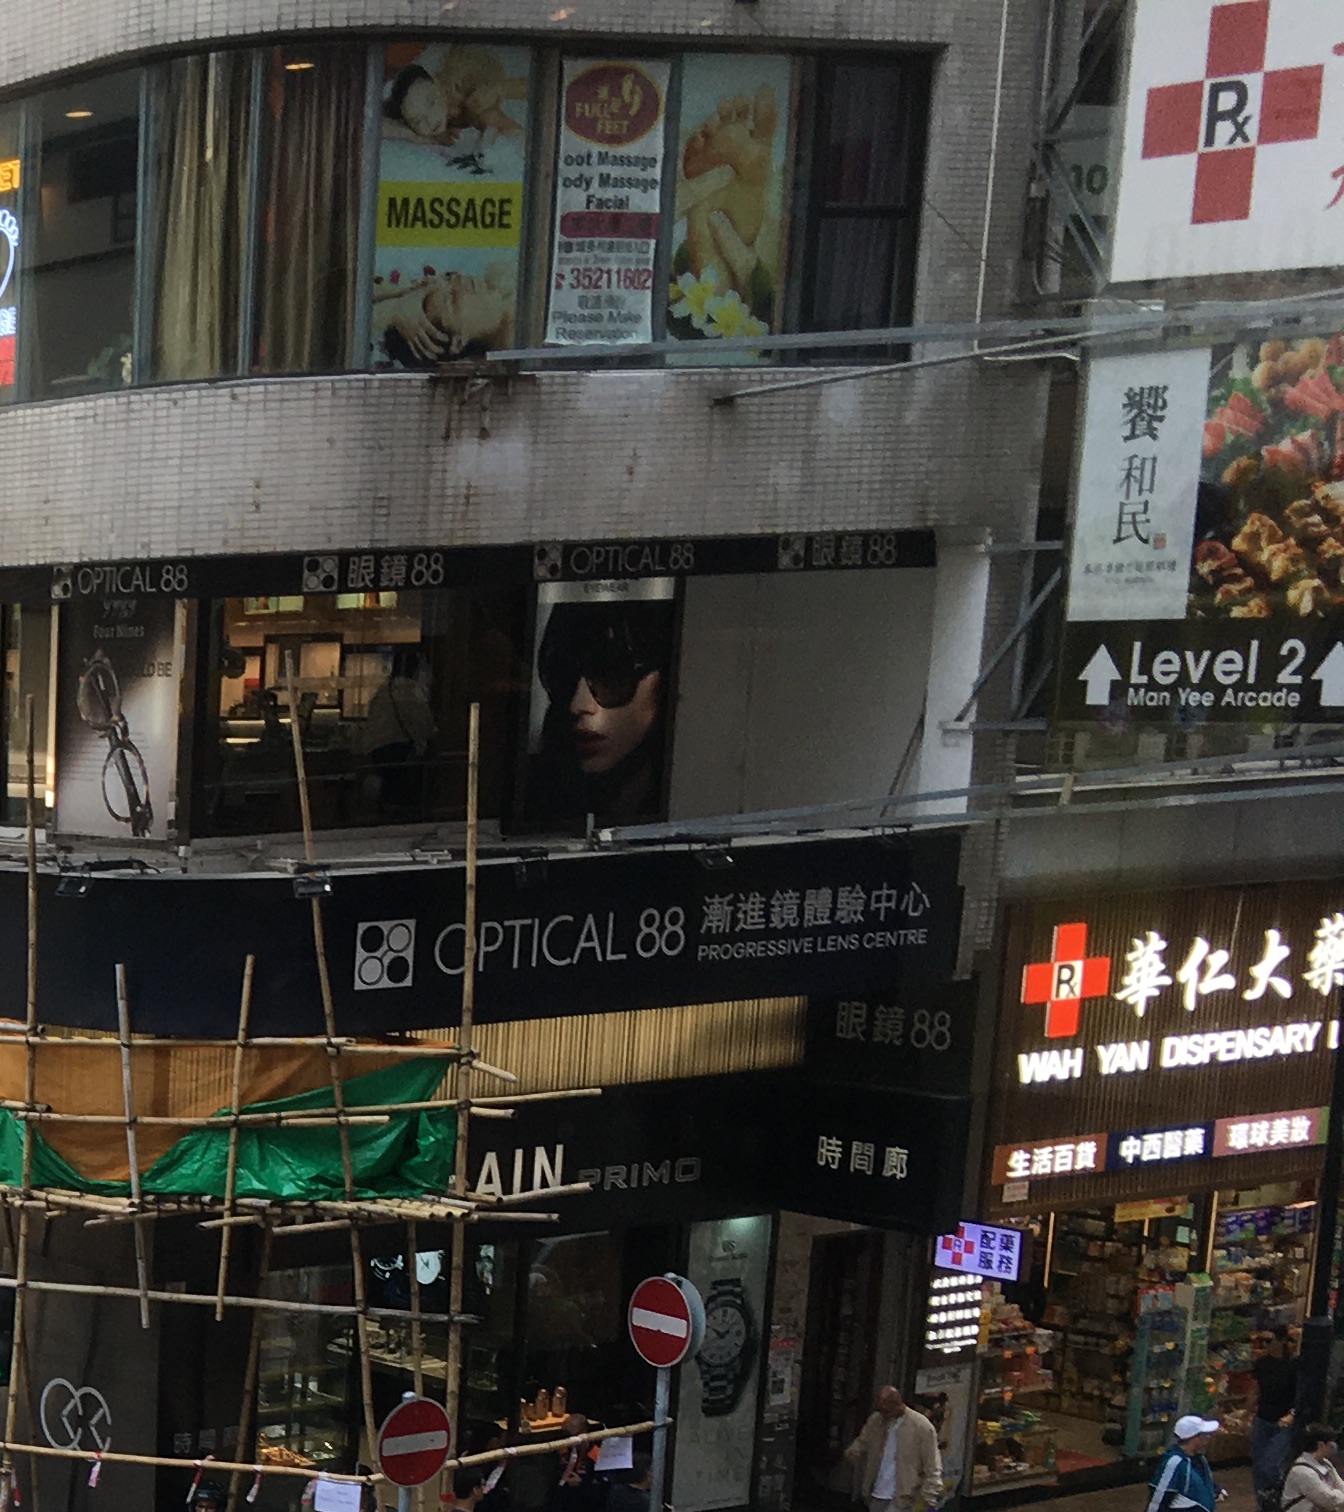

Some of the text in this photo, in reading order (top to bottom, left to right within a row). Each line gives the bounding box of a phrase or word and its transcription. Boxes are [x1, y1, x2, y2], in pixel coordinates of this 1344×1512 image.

[575, 102, 611, 119] FULL
[596, 121, 630, 135] FEET
[564, 152, 657, 171] oot Massage
[563, 174, 659, 193] ody Massage
[386, 197, 512, 229] MASSAGE
[586, 195, 630, 210] Facial
[552, 311, 604, 325] Please
[1113, 385, 1169, 546] 饗和民
[569, 544, 696, 575] OPTICAL 88
[866, 534, 898, 565] 88
[77, 565, 189, 595] OPTICAL 88
[347, 553, 445, 589] 眼鏡 88
[1130, 638, 1307, 685] Level 2
[1127, 687, 1301, 707] Man Yee Arcade
[698, 881, 932, 935] 漸進鏡體驗中心
[434, 906, 686, 976] OPTICAL 88
[696, 928, 929, 962] PROGRESSIVE LENS CENTRE
[834, 1001, 953, 1052] 眼鏡 88
[1016, 1047, 1083, 1086] WAH
[1096, 1039, 1150, 1077] YAN
[1159, 1021, 1322, 1070] DISPENSARY
[816, 1134, 909, 1182] 時間廊
[1006, 1139, 1099, 1179] 生活百貨
[1118, 1125, 1206, 1166] 中西醫藥
[475, 1144, 701, 1199] AIN PRIMO
[979, 1229, 1015, 1254] 配藥
[977, 1250, 1013, 1274] 服務
